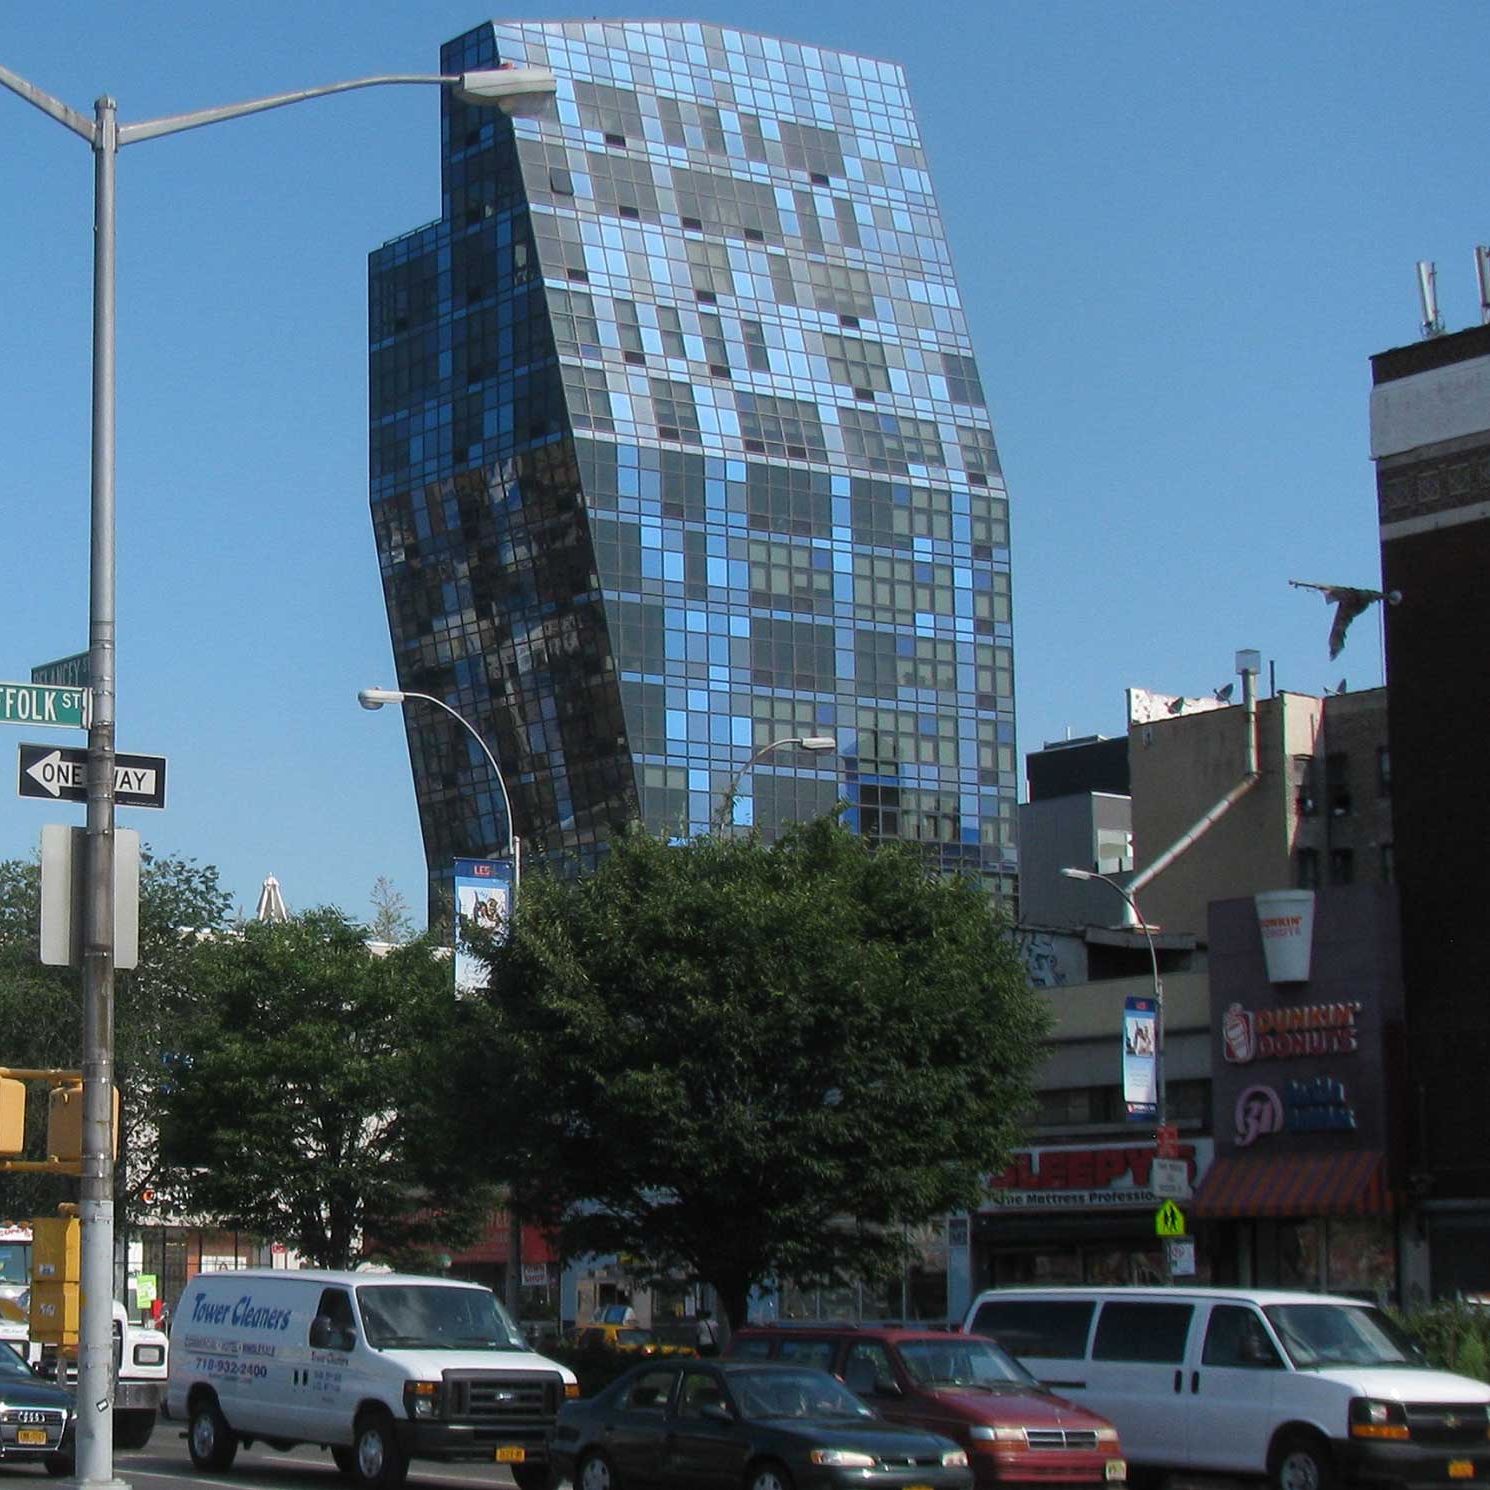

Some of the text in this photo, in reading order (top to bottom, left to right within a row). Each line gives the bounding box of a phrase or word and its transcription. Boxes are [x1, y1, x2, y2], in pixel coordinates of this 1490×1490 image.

[62, 693, 80, 709] ST
[42, 763, 147, 791] ONE AY
[1256, 1002, 1361, 1033] DUNKIN'
[1258, 1028, 1358, 1057] DONUTS
[990, 1145, 1197, 1189] SLEEPYS
[1026, 1190, 1085, 1205] Mattress
[1089, 1185, 1158, 1203] Professio
[192, 1293, 293, 1330] Tower Cleaners
[196, 1357, 268, 1378] 718-932-2400
